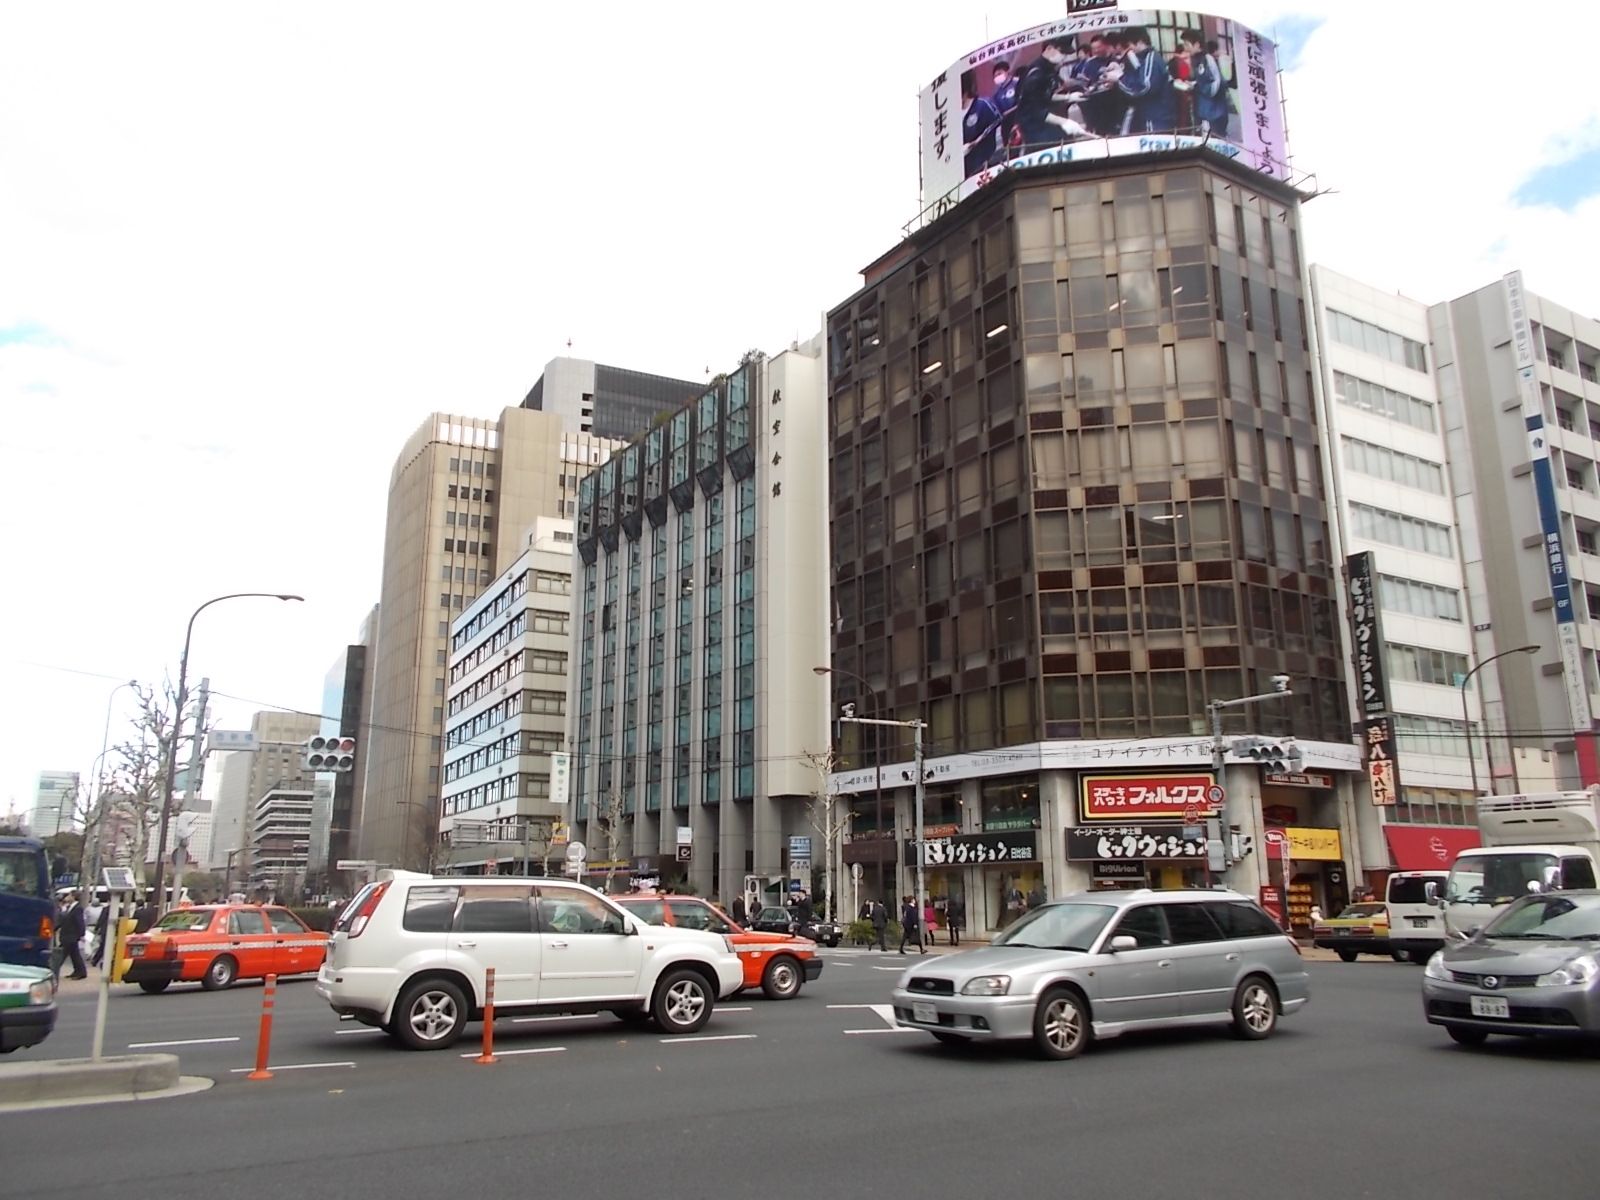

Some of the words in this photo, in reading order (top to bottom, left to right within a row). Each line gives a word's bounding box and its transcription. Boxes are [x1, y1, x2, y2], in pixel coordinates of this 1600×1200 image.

[1547, 532, 1564, 574] 横浜銀行
[1093, 787, 1125, 797] ステーキ
[1129, 785, 1207, 805] フォルクス
[1094, 797, 1126, 806] ハウス
